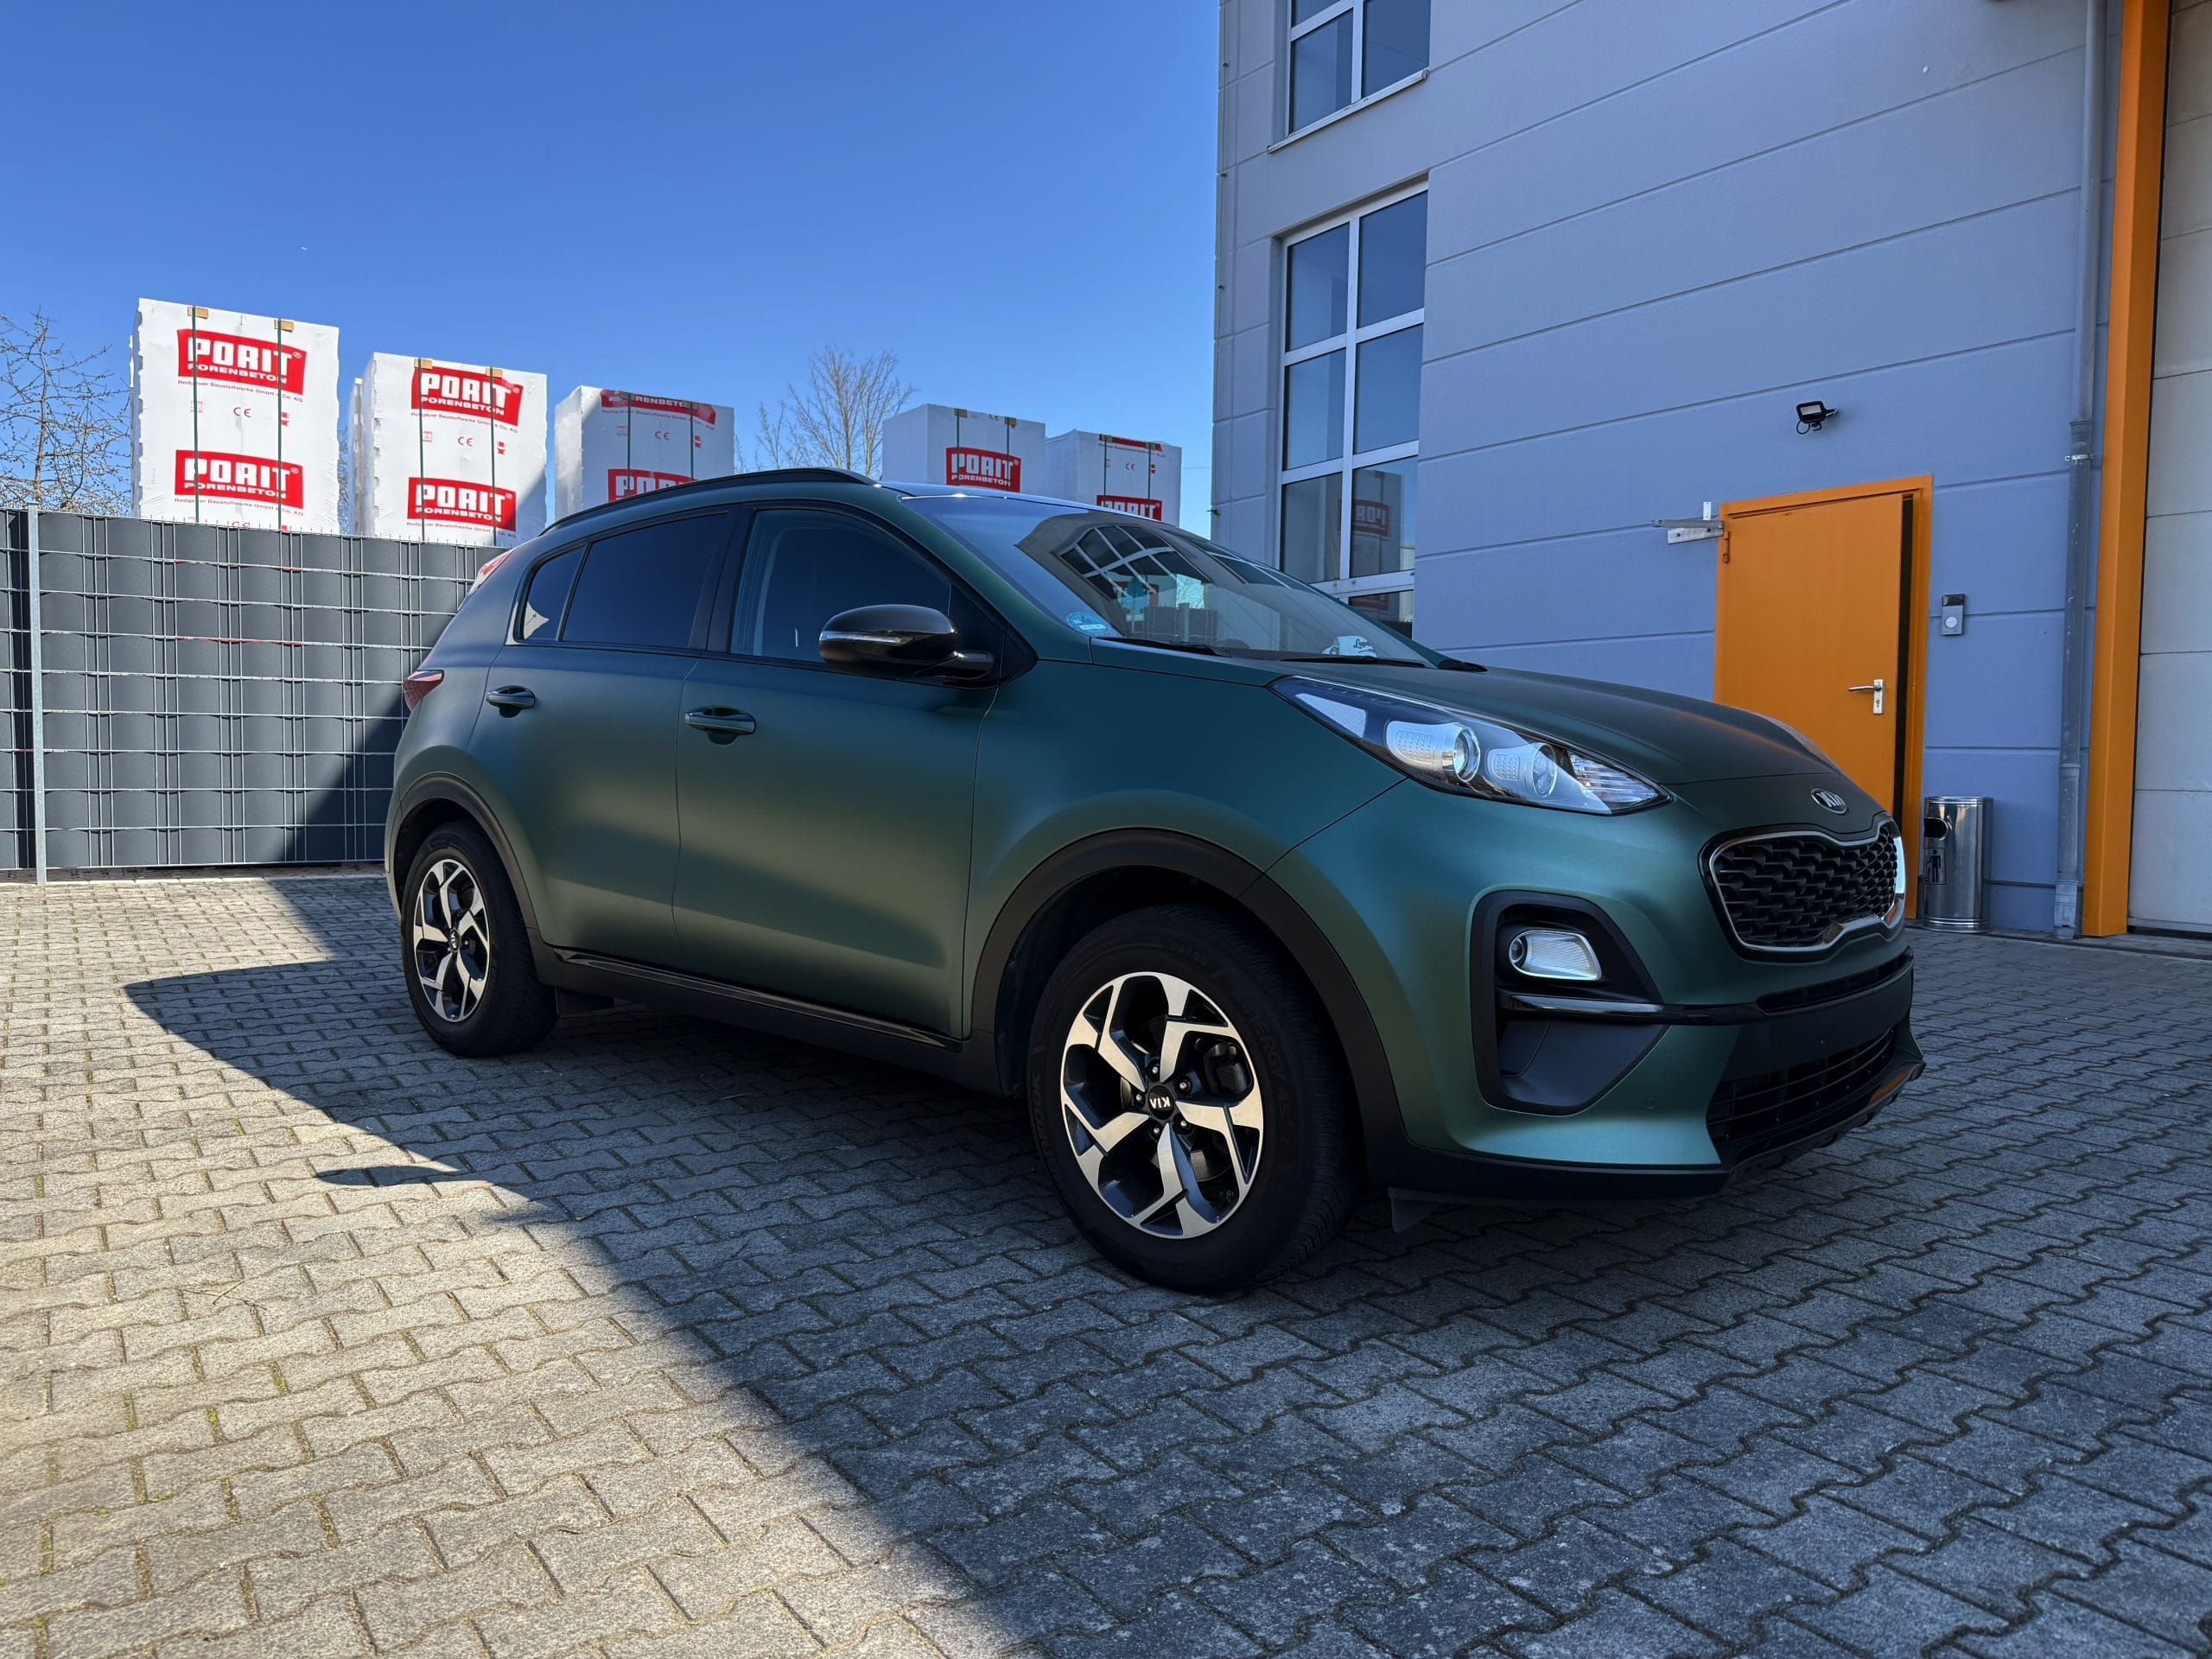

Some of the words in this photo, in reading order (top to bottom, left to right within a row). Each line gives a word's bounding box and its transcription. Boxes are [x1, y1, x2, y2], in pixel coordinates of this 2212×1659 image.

[188, 337, 293, 376] PORIT
[188, 363, 287, 384] PORENBETON
[421, 372, 512, 409] PORIT
[422, 397, 505, 416] PORENBETON
[184, 457, 291, 492] PORIT
[951, 453, 1014, 480] PORIT
[184, 482, 287, 499] PORENBETON
[416, 484, 505, 515] PORIT
[415, 507, 502, 522] PORENBETON
[1149, 1096, 1171, 1109] KIA
